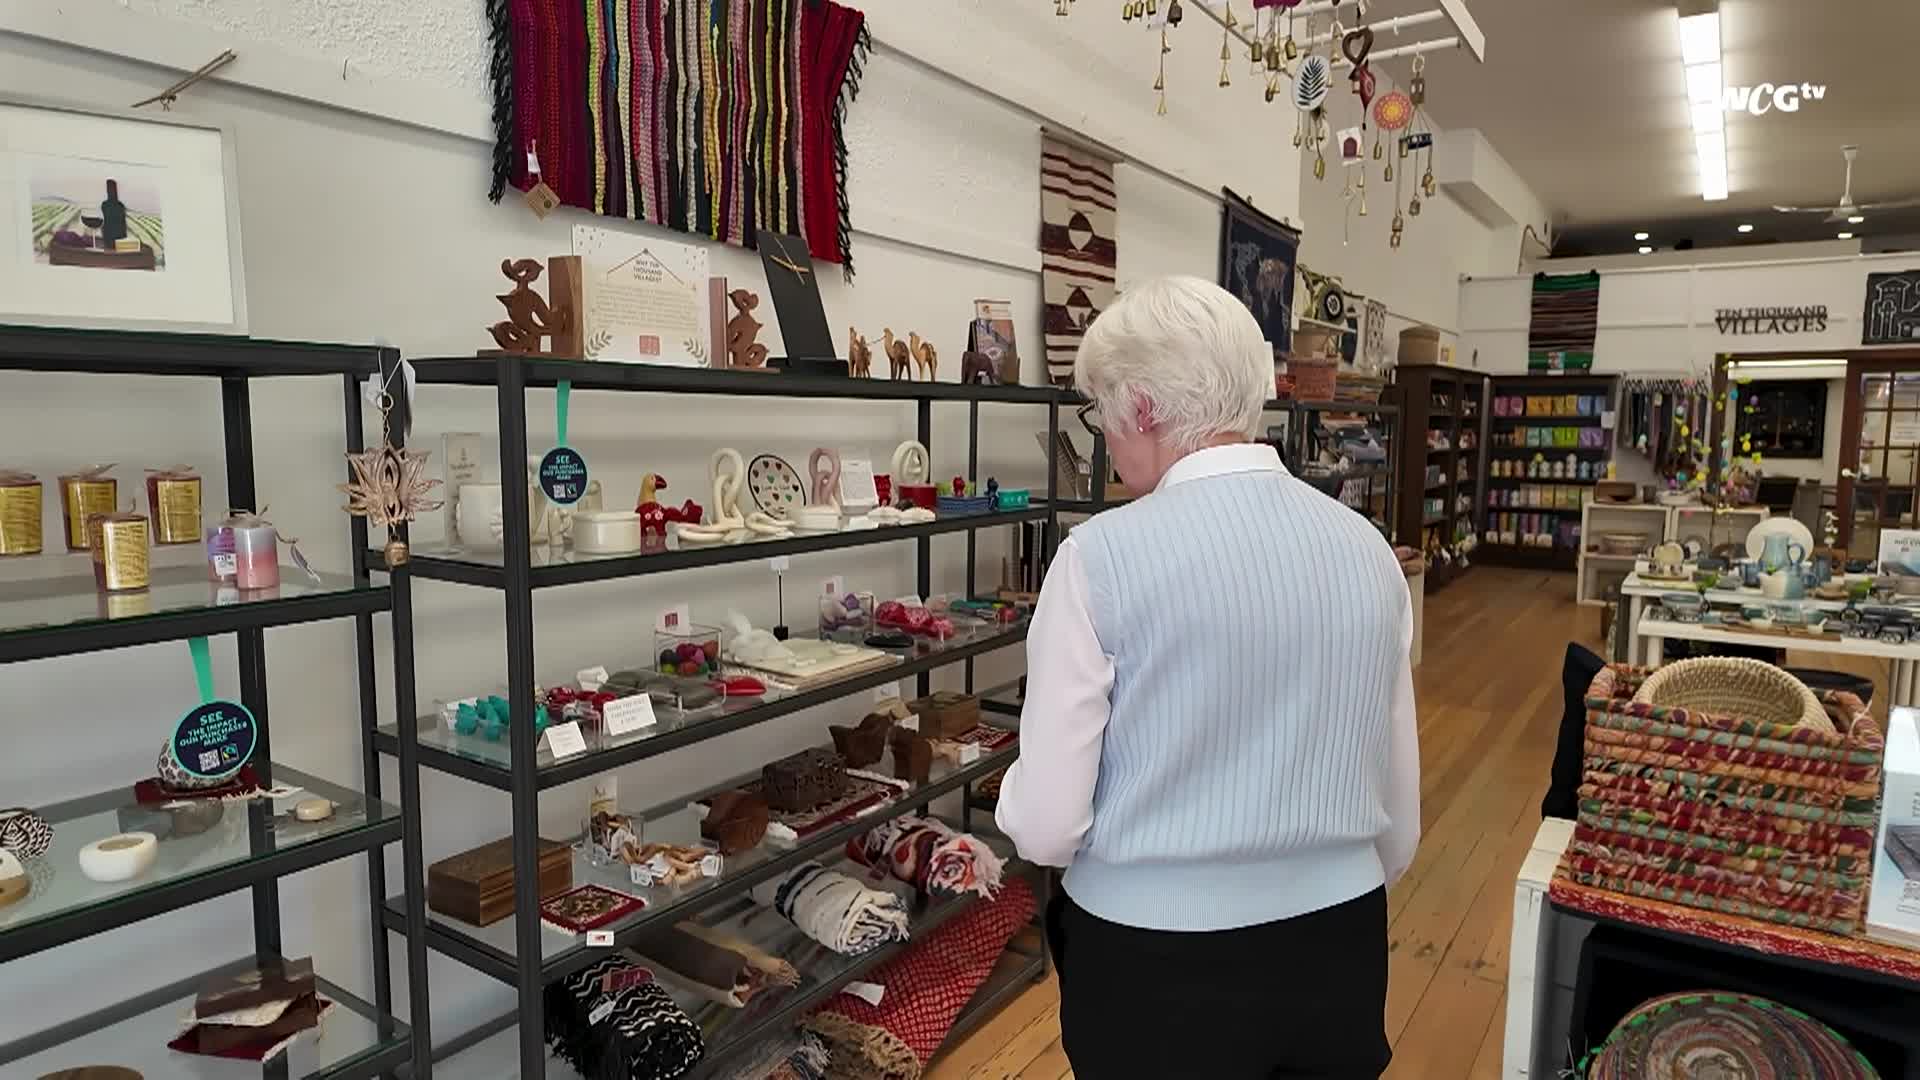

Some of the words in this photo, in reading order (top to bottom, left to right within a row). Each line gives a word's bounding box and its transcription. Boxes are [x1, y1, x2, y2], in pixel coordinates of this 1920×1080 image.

[1715, 307, 1742, 320] TEN
[1745, 304, 1828, 320] THOUSAND
[1715, 317, 1828, 335] VILLAGES
[555, 455, 570, 464] SEE
[200, 711, 224, 726] SEE
[187, 726, 206, 738] THE
[206, 717, 238, 731] IMPACT
